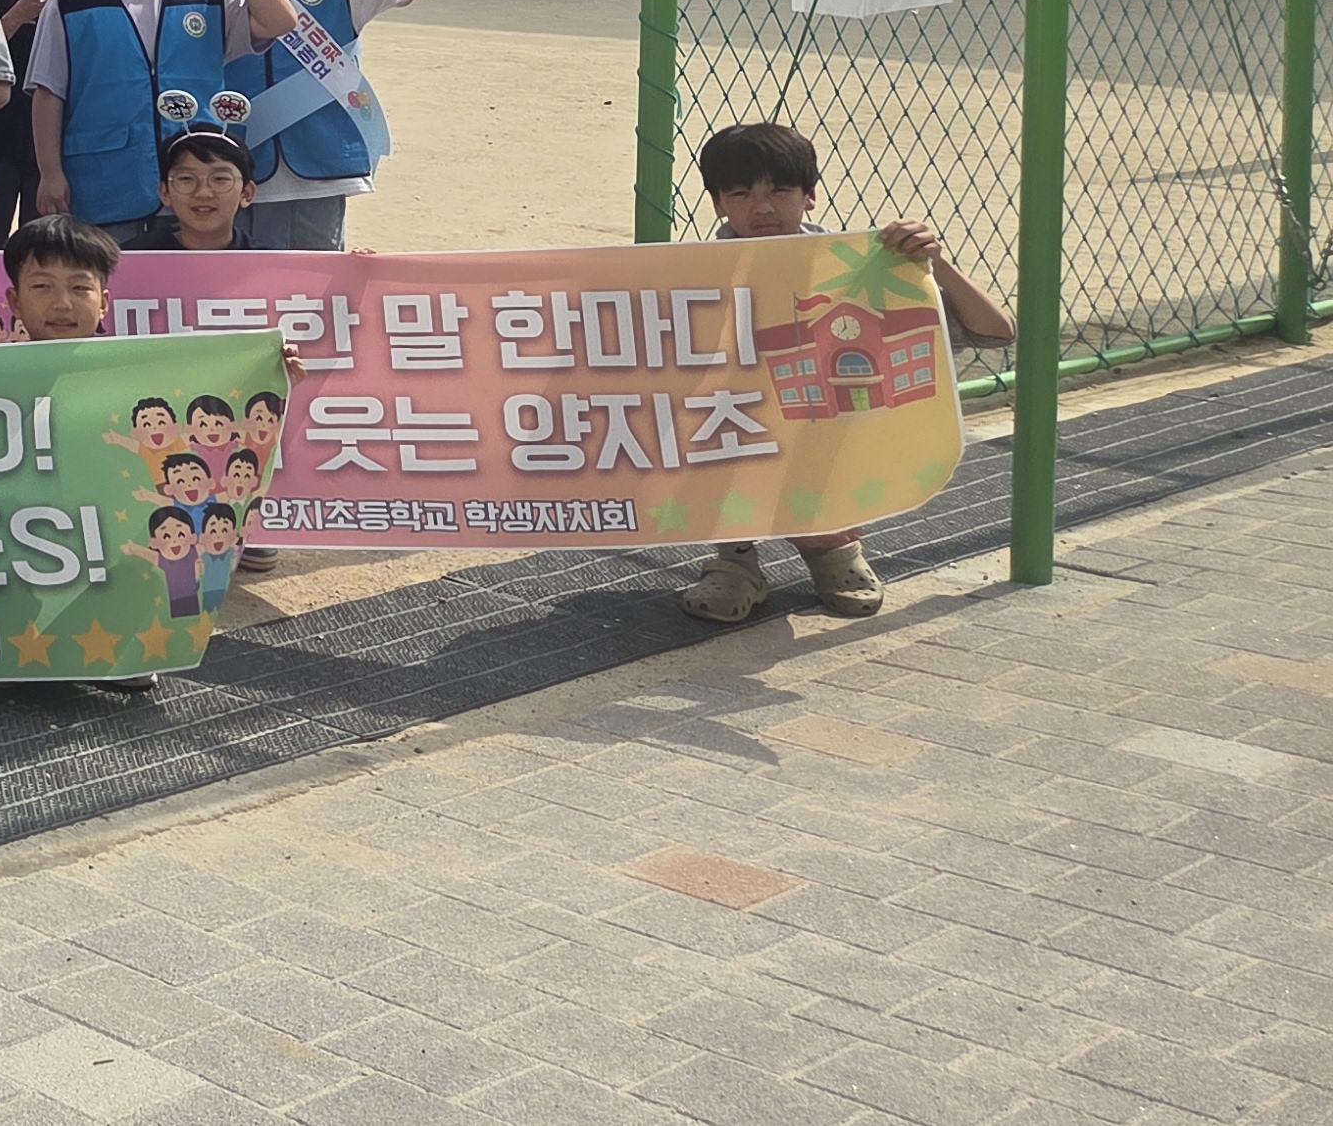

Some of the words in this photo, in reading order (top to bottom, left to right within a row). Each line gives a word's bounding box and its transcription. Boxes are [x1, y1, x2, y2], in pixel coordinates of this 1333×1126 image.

[383, 293, 470, 370] 말
[492, 287, 758, 369] 한마디
[305, 396, 480, 472] 웃는
[502, 390, 779, 472] 양지초
[259, 498, 460, 533] 양지초등학교
[464, 498, 639, 534] 학생자치회
